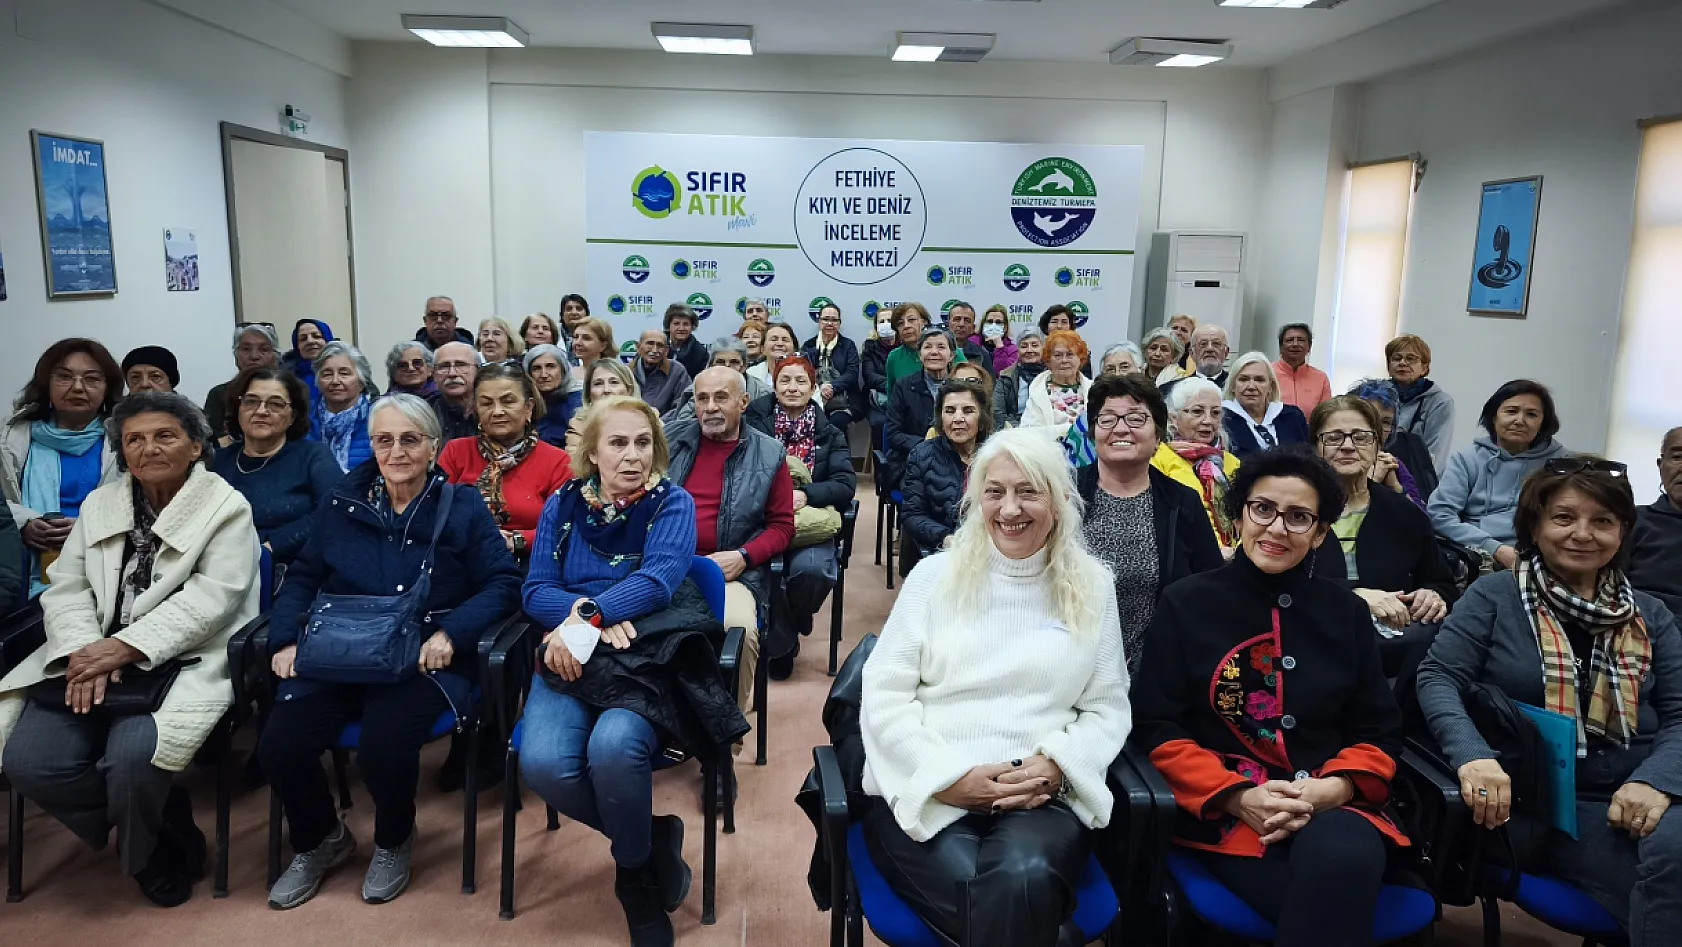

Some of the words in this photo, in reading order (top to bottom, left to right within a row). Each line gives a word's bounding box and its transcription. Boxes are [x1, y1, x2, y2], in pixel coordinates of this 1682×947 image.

[1035, 160, 1059, 171] MARINE
[686, 170, 747, 193] SIFIR
[835, 166, 896, 188] FETHİYE
[687, 194, 747, 217] ATIK
[808, 196, 837, 215] KIYI
[842, 196, 862, 215] VE
[866, 193, 912, 215] DENİZ
[1061, 198, 1096, 207] TURMEPA
[824, 220, 902, 241] İNCELEME
[830, 246, 898, 268] MERKEZİ
[692, 260, 718, 270] SIFIR
[693, 270, 718, 280] ATIK
[948, 266, 973, 276] SIFIR
[1076, 268, 1101, 277] SIFIR
[948, 275, 972, 285] ATIK
[1075, 277, 1100, 287] ATIK
[628, 295, 653, 305] SIFIR
[763, 297, 781, 307] FIR
[629, 304, 653, 314] ATIK
[1008, 304, 1034, 314] SIFIR
[1009, 314, 1033, 323] ATIK
